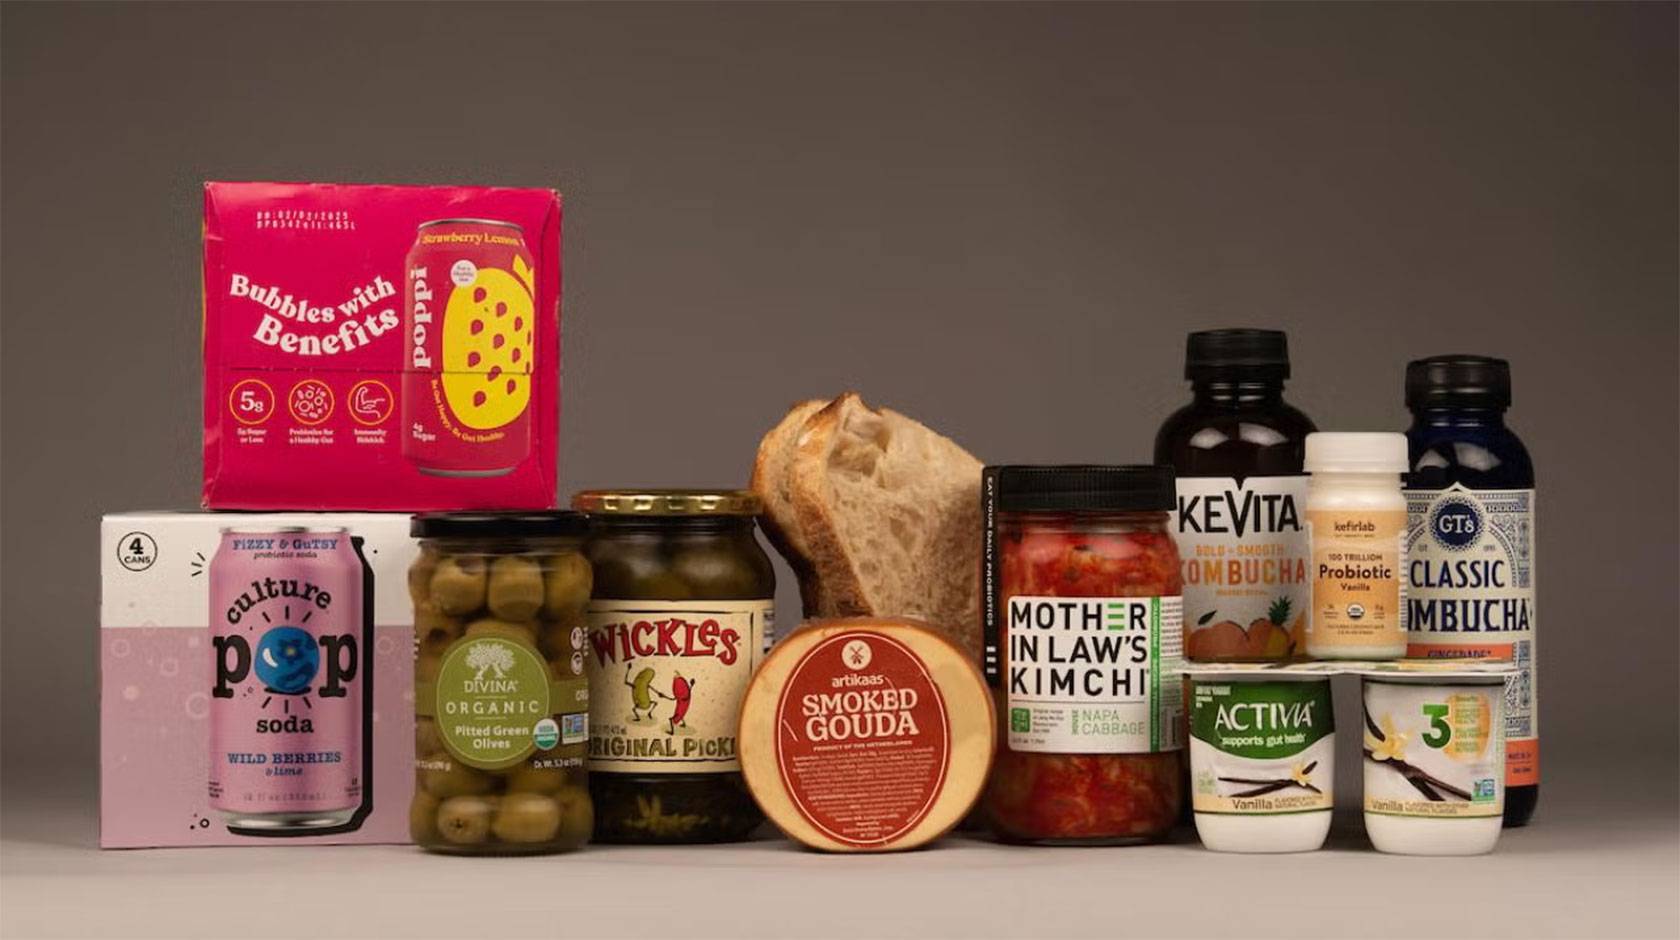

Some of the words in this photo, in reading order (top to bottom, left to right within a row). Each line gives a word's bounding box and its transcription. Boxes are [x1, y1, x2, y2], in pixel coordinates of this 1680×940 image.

[422, 231, 483, 246] Strawberry
[484, 232, 520, 246] Lemon
[230, 273, 336, 323] Bubbles
[337, 275, 396, 317] with
[410, 266, 432, 368] poppi
[253, 309, 400, 356] Benefits
[240, 391, 264, 412] 5g
[1334, 520, 1375, 531] kefirlab
[1439, 514, 1475, 534] GT's
[129, 538, 144, 555] 4
[232, 539, 274, 550] FiZZY
[279, 539, 289, 550] &
[124, 555, 151, 564] CANS
[1319, 564, 1392, 579] Probiotic
[1410, 560, 1505, 588] CLASSIC
[227, 576, 332, 624] culture
[1010, 601, 1147, 631] MOTHER
[1408, 598, 1530, 632] MBUCHA
[1010, 635, 1038, 662] IN
[1049, 635, 1147, 663] LAW'S
[464, 680, 516, 693] DIVINA
[832, 674, 884, 688] artikaas
[1010, 667, 1145, 696] KIMCHI
[446, 700, 540, 714] ORGANIC
[802, 688, 918, 717] SMOKED
[1082, 709, 1120, 721] NAPA
[1214, 702, 1312, 730] ACTIVIA
[256, 715, 314, 734] soda
[455, 725, 491, 736] Pitted
[493, 725, 529, 736] Green
[805, 711, 920, 742] GOUDA
[1082, 722, 1145, 735] CABBAGE
[1421, 704, 1451, 749] 3
[473, 738, 510, 749] Olives
[1222, 735, 1264, 747] supports
[1266, 734, 1283, 747] gut
[227, 753, 267, 764] WILD
[272, 751, 342, 764] BERRIES
[274, 767, 304, 776] lime
[1231, 799, 1273, 810] Vanilla
[1372, 800, 1403, 812] Vanilla
